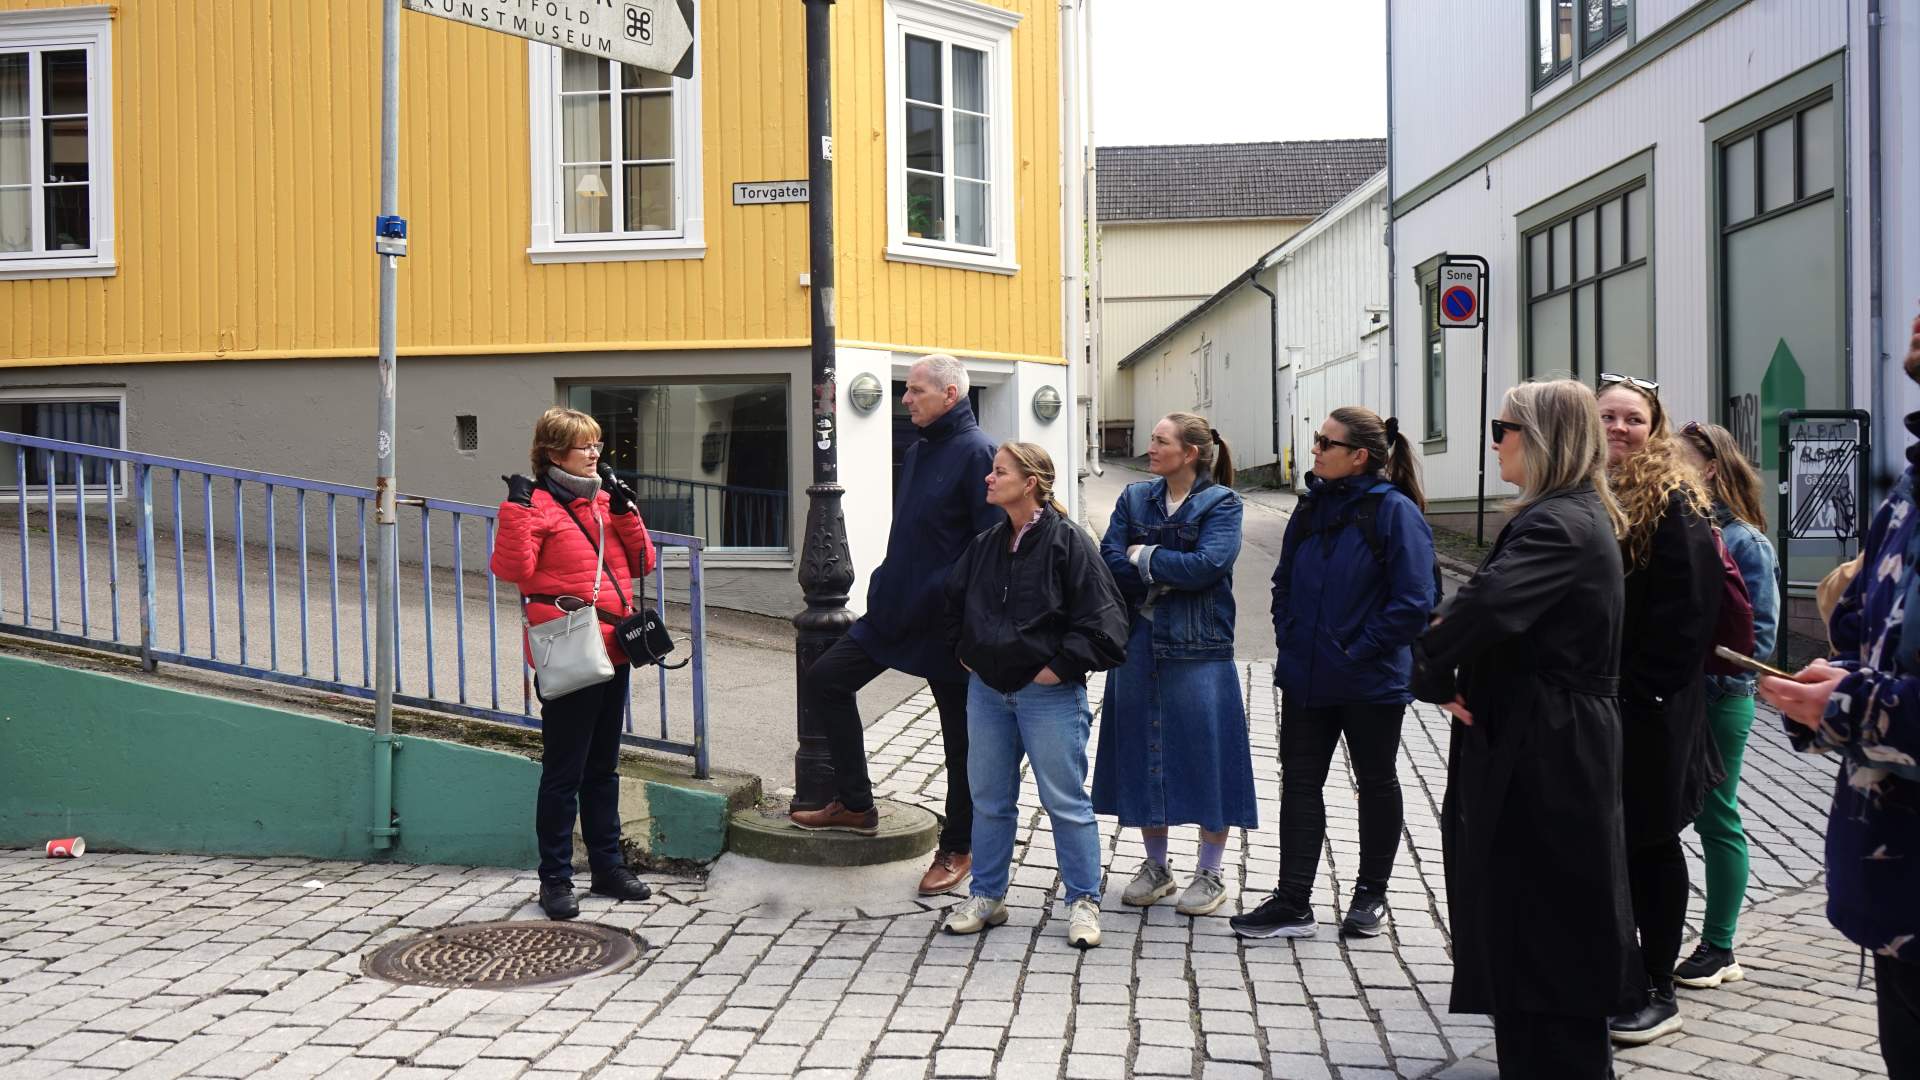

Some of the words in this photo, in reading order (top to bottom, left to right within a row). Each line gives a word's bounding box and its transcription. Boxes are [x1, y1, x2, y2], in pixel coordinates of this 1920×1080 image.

[500, 0, 590, 24] FOLD
[424, 0, 612, 53] KUNSTMUSEUM
[740, 186, 807, 201] Torvgaten
[1446, 269, 1473, 281] Sone
[625, 621, 656, 641] MIPO
